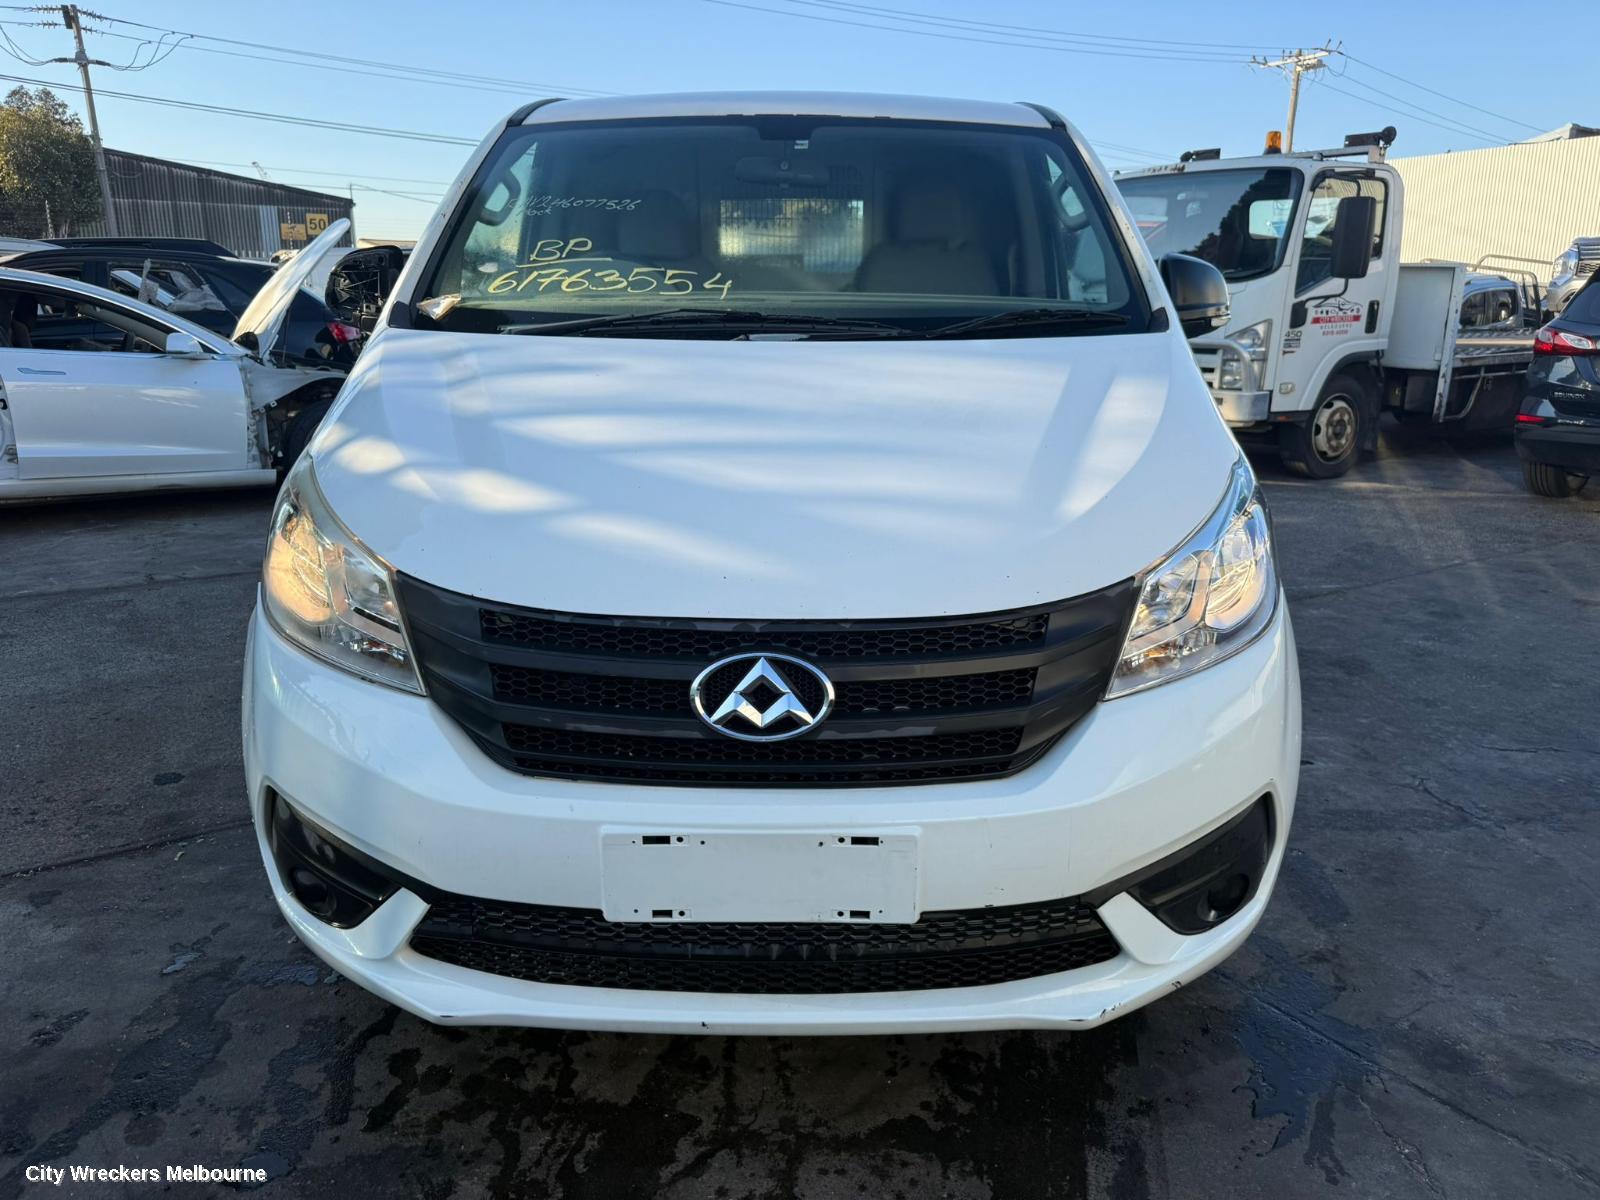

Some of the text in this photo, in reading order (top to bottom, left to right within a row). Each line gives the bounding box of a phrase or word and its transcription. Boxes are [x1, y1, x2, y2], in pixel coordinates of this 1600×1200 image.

[309, 218, 327, 231] 50
[529, 237, 594, 262] BP
[487, 267, 733, 300] 61763554
[1285, 330, 1303, 338] 450
